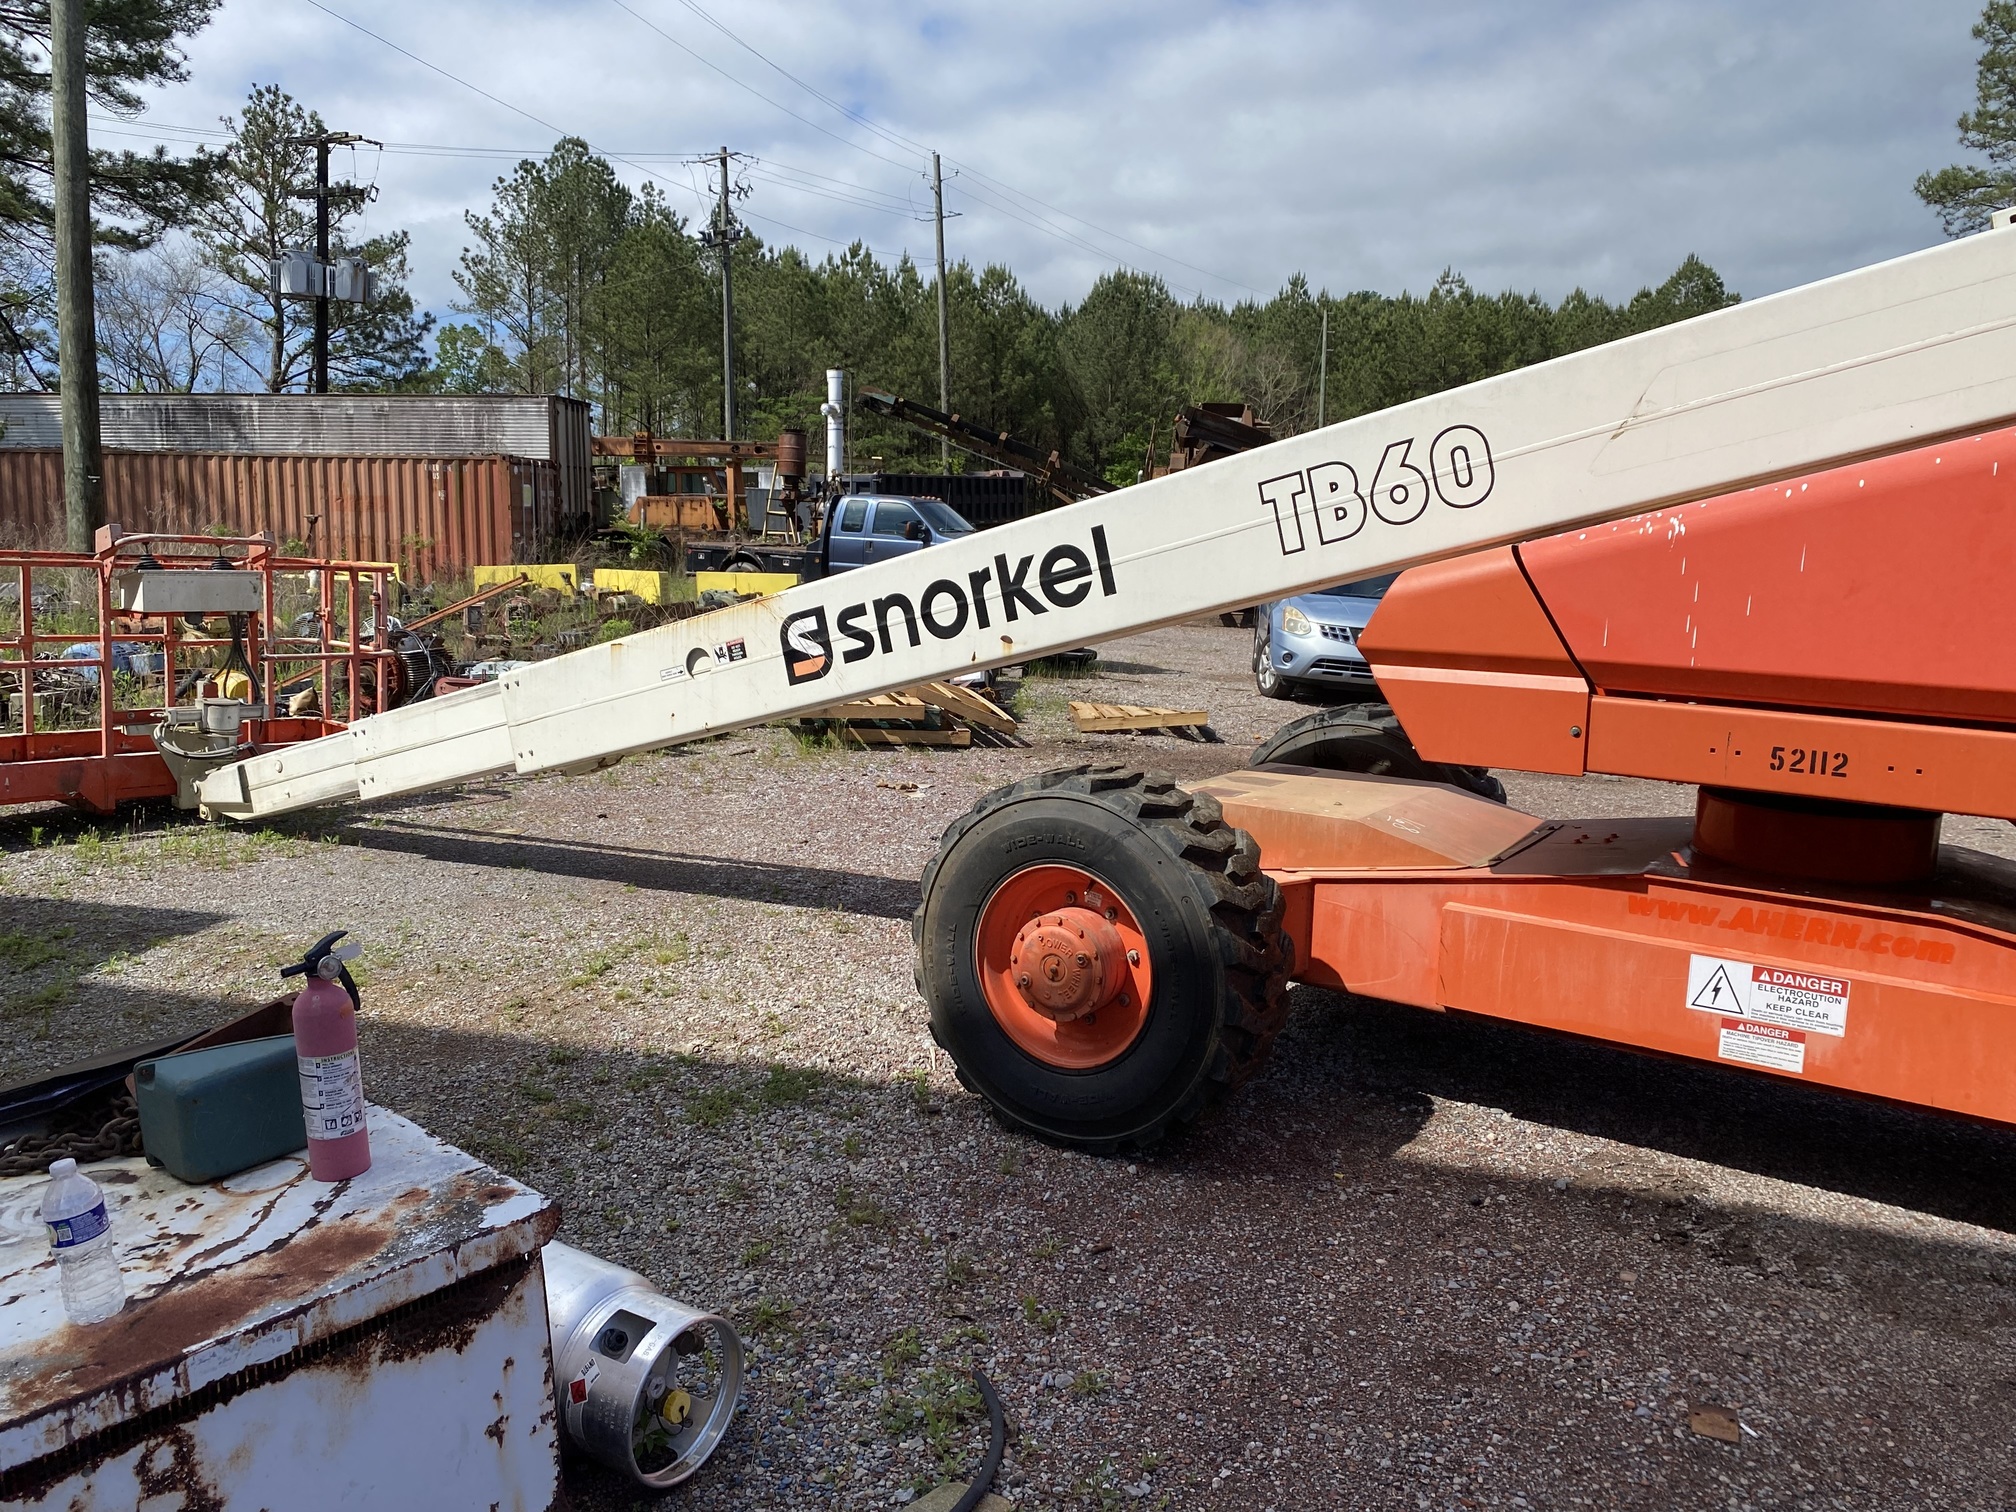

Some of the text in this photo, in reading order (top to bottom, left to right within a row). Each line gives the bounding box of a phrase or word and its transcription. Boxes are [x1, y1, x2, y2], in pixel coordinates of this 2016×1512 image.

[1257, 424, 1495, 556] TB60
[836, 523, 1117, 664] snorkel
[1769, 745, 1849, 778] 52112
[1000, 833, 1087, 854] WIDE-WALL
[1627, 895, 1956, 965] www.AHERN.com
[1773, 971, 1842, 994] DANGER
[1757, 984, 1842, 1005] ELECTROCUTION
[1778, 994, 1819, 1009] HAZARD
[1766, 1002, 1829, 1021] KEEP CLEAR
[1726, 1030, 1750, 1040] MACHINE
[1752, 1035, 1775, 1045] TIPOVER
[1776, 1039, 1799, 1049] HAZARD
[1746, 1023, 1789, 1039] DANGER
